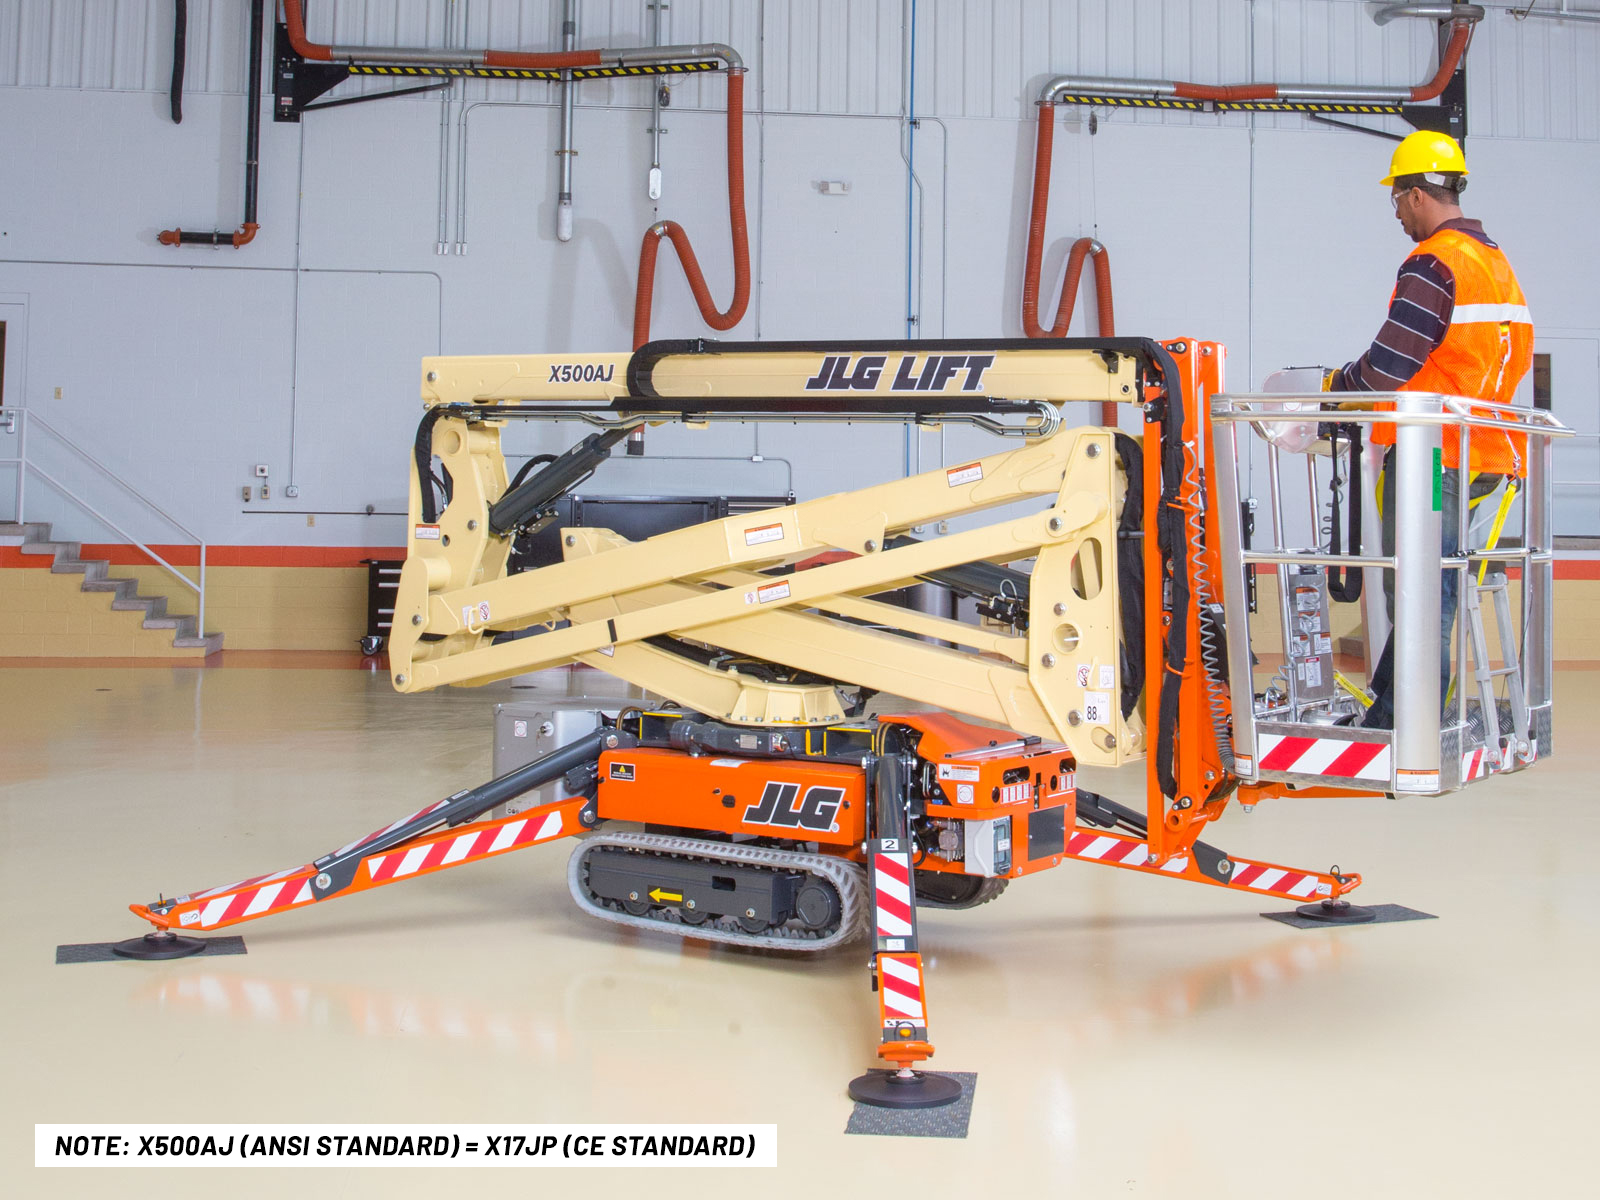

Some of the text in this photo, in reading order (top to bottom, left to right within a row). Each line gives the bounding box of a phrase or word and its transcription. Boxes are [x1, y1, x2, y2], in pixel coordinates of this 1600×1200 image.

[548, 364, 614, 383] X500AJ
[804, 355, 996, 392] JLG LIFT
[1087, 706, 1097, 720] 88
[742, 781, 846, 832] JLG
[884, 839, 896, 850] 2
